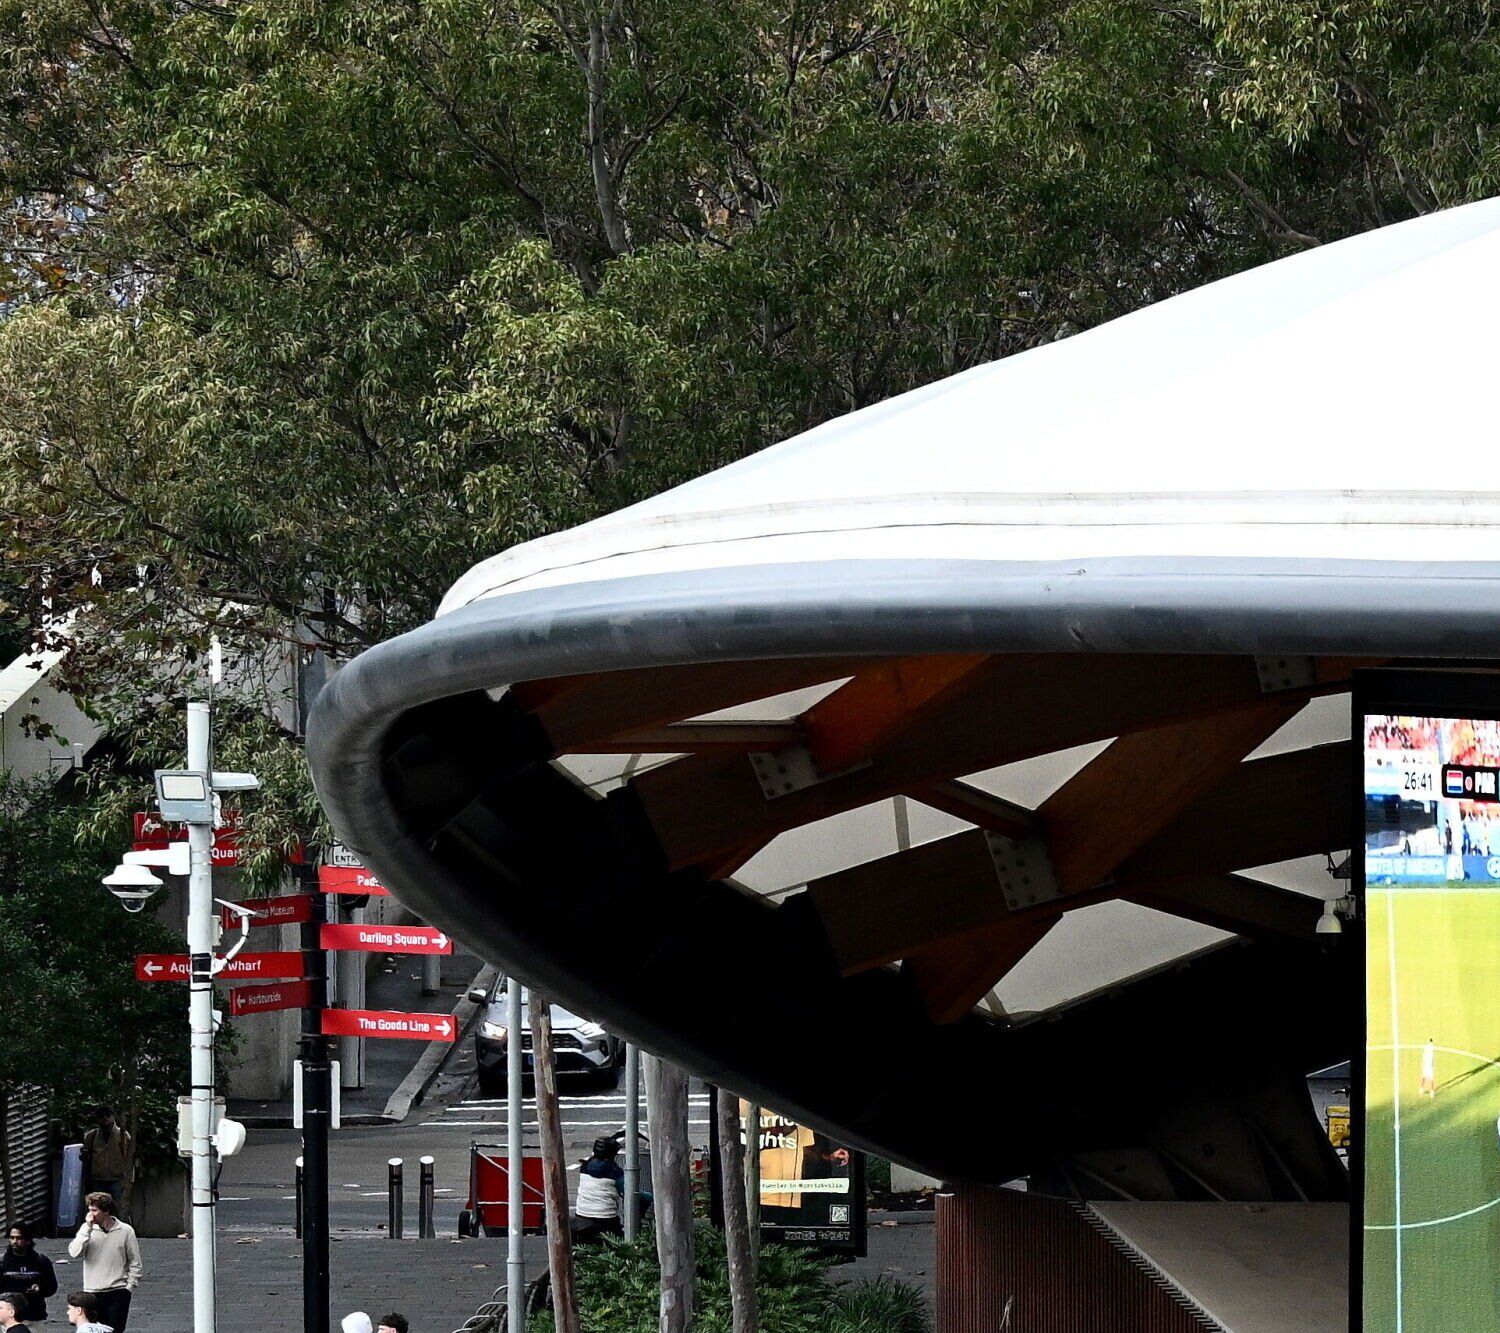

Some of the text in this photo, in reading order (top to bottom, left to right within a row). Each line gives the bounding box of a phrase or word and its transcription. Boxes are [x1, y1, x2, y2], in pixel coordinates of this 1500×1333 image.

[1404, 771, 1433, 791] 26:41
[1475, 772, 1496, 794] PAR
[360, 932, 428, 946] Darling Square
[228, 960, 261, 972] Wharf
[358, 1018, 430, 1033] The Goods Line
